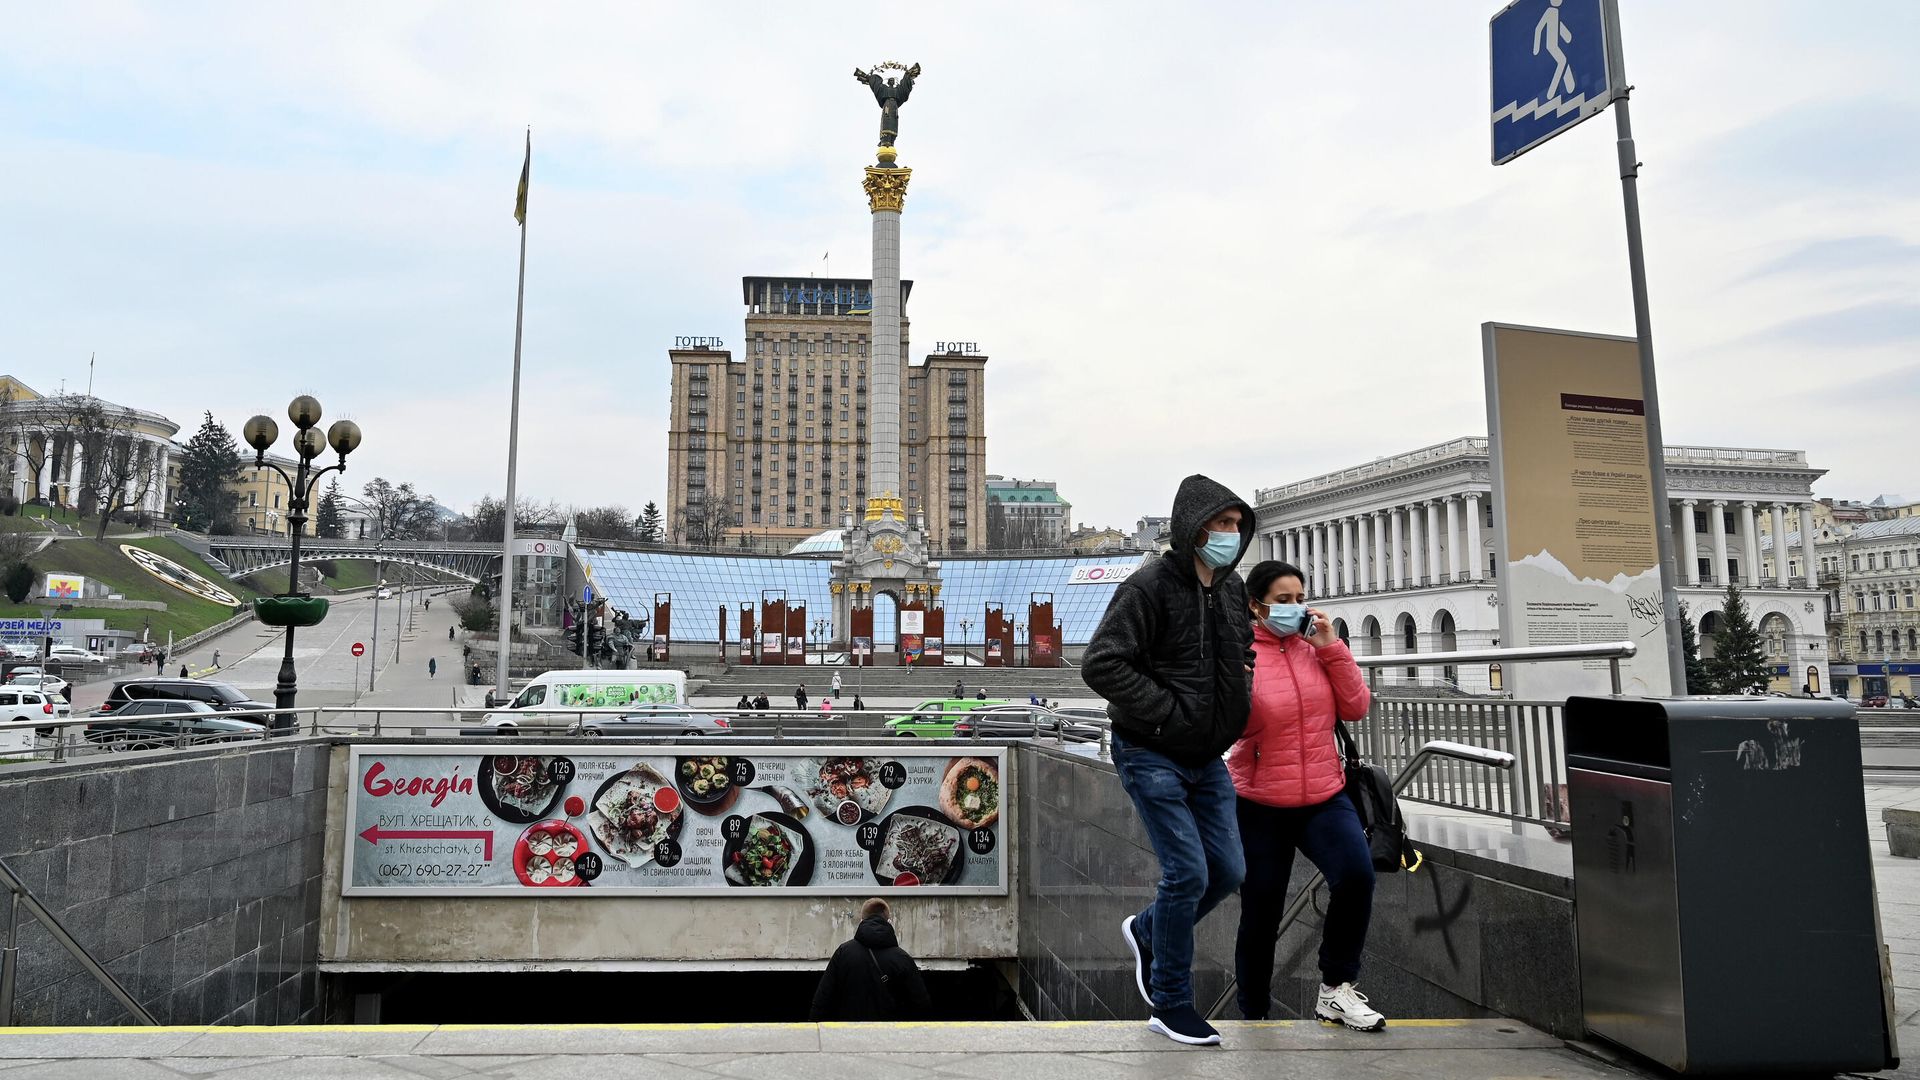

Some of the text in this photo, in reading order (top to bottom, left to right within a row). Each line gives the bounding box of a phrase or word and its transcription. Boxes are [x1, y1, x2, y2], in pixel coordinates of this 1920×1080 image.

[675, 336, 723, 347] ГОТЕЛЬ
[936, 341, 981, 352] HOTEL
[526, 542, 560, 554] GLOBUS
[1075, 567, 1131, 580] GLOBUS
[27, 621, 61, 631] МЕДУЗ
[554, 762, 570, 774] 125
[578, 761, 616, 770] ЛЮЛЯ-КЕБАБ
[736, 762, 747, 775] 75
[757, 762, 786, 771] ПЕЧЕРИЦІ
[908, 766, 936, 774] ШАШЛИК
[578, 771, 604, 780] КУРЯЧИЙ
[757, 773, 785, 781] ЗАПЕЧЕНІ
[883, 766, 894, 777] 79
[364, 762, 473, 808] Georgia
[379, 814, 492, 829] ВУЛ. ХРЕЩАТИК, 6
[730, 819, 741, 831] 89
[695, 828, 714, 836] ОВОЧІ
[863, 827, 878, 839] 139
[974, 830, 990, 843] 134
[385, 842, 482, 855] st. Khreshchatyk, 6
[695, 839, 724, 847] ЗАПЕЧЕНІ
[659, 843, 669, 855] 95
[825, 849, 864, 858] ЛЮЛЯ-КЕБАБ
[586, 857, 597, 869] 16
[683, 857, 712, 865] ШАШЛИК
[822, 861, 864, 869] З ЯЛОВИЧИНИ
[378, 863, 412, 877] (067)
[603, 863, 627, 872] ХІНКАЛІ
[643, 867, 712, 877] ЗІ СВИНЯЧОГО ОШИЙКА
[828, 872, 864, 880] ТА СВИНИНИ
